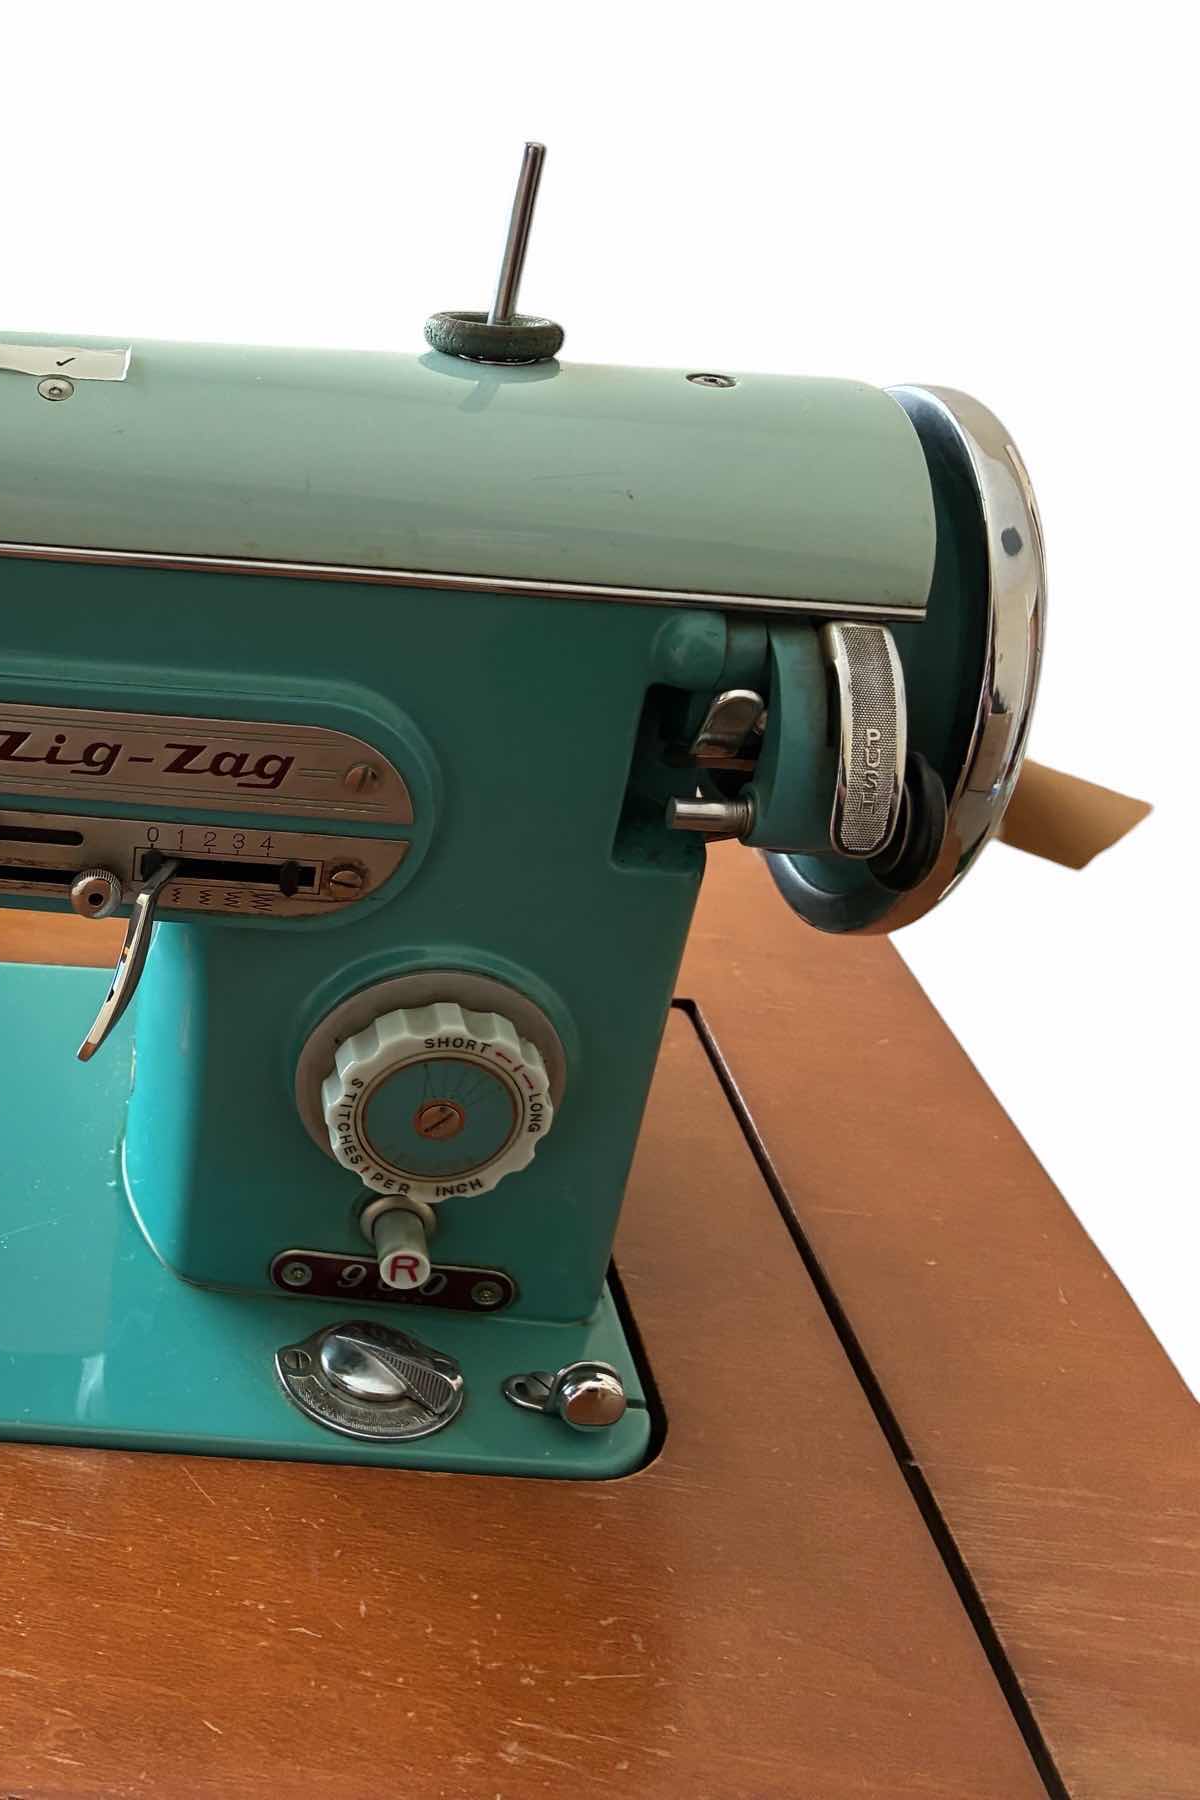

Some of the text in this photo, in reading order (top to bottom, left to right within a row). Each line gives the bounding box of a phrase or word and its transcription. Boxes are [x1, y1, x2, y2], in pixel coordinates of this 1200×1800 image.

[856, 728, 882, 815] PUSH
[203, 831, 217, 847] 2
[232, 833, 246, 850] 3
[260, 835, 275, 851] 4
[424, 1037, 492, 1055] SHORT
[527, 1092, 543, 1133] LONG
[336, 1078, 483, 1197] STITCHES PER INCH
[337, 1264, 448, 1296] 90
[390, 1255, 418, 1282] R
